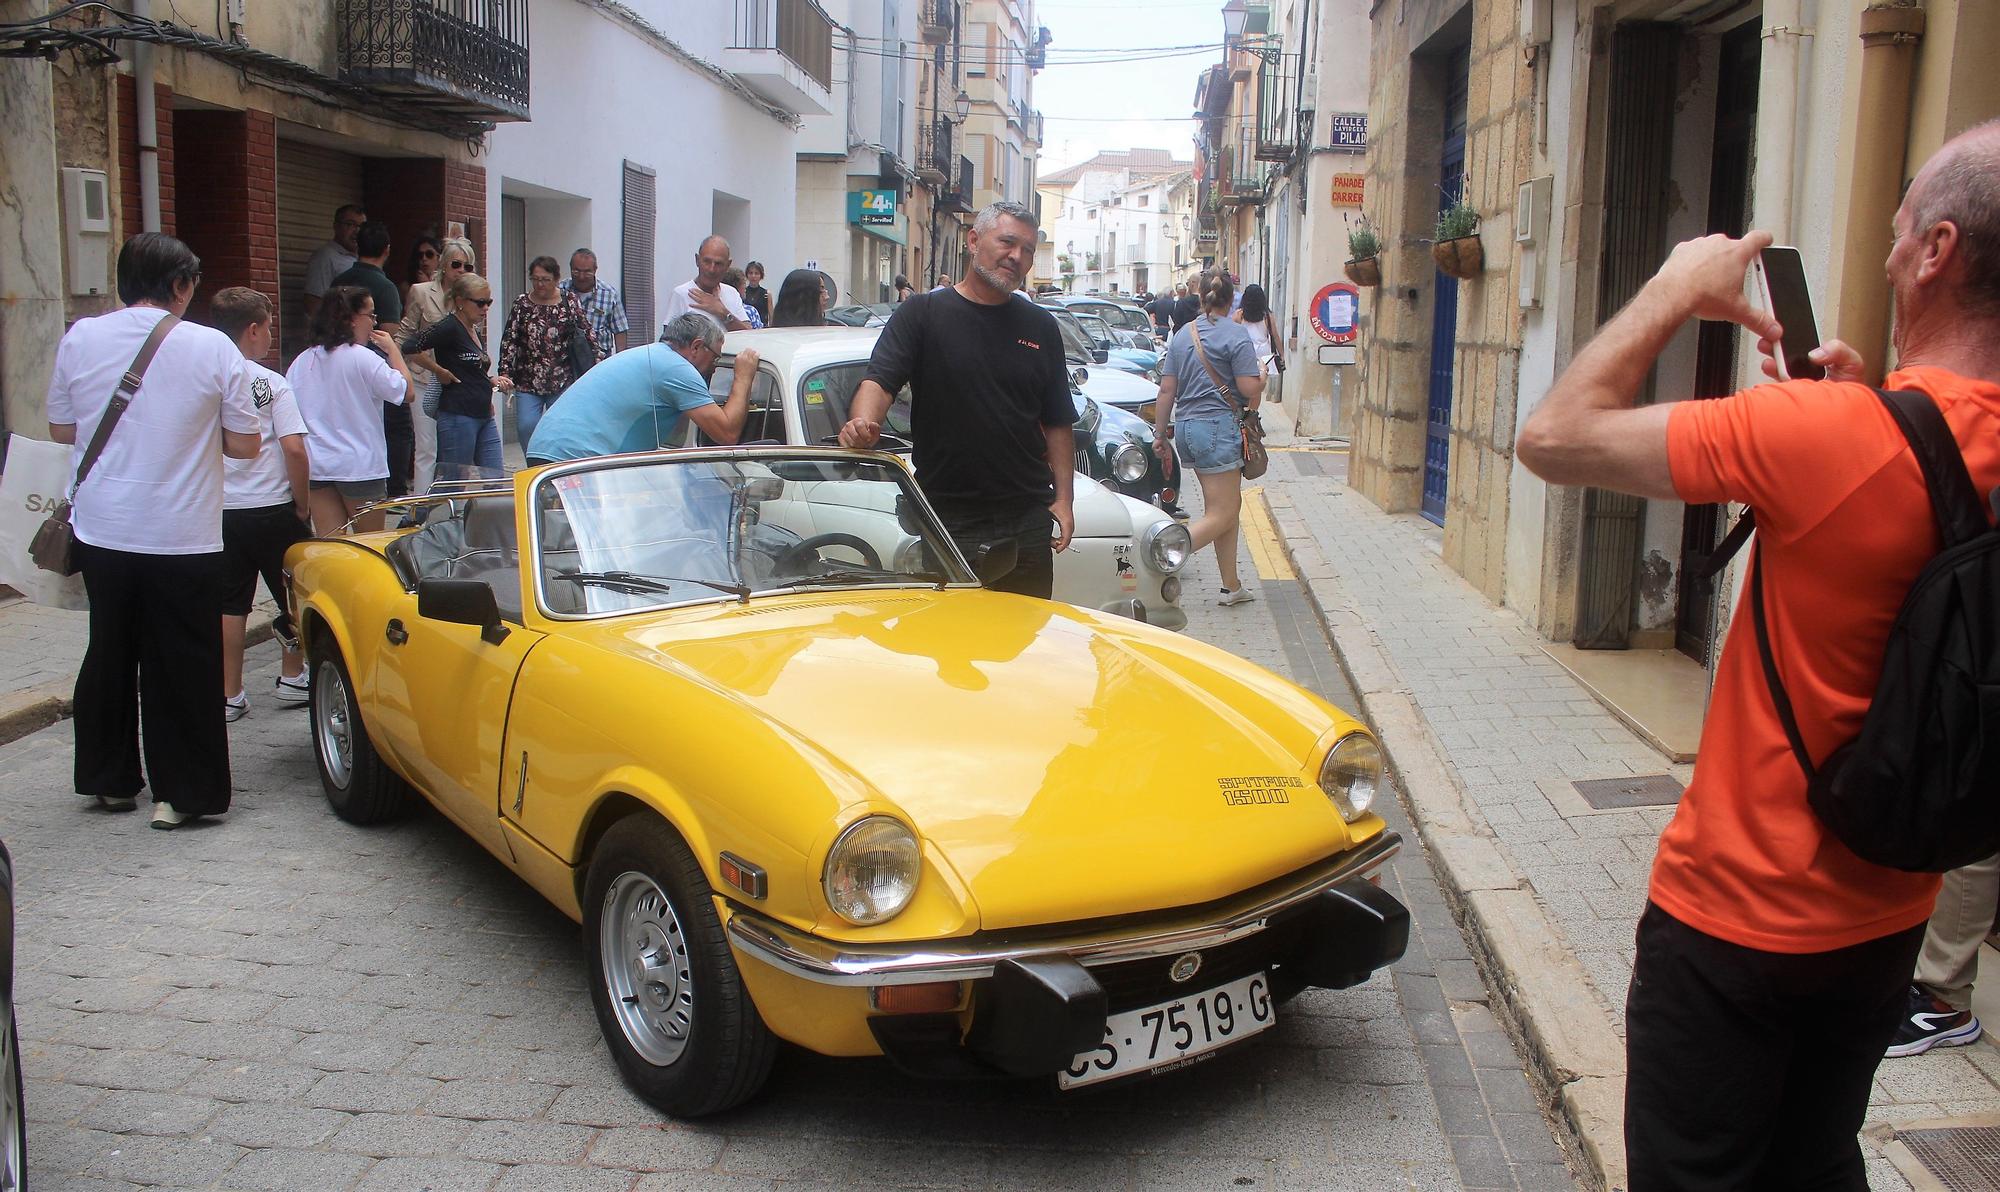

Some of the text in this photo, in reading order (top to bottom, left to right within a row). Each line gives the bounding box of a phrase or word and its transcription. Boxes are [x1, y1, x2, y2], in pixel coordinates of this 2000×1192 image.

[1334, 117, 1361, 126] CALLE
[1340, 132, 1366, 144] PILAR
[862, 191, 892, 213] 24h
[1312, 316, 1320, 328] EN
[1217, 776, 1303, 789] SPITFIRE
[1222, 788, 1289, 806] 1500
